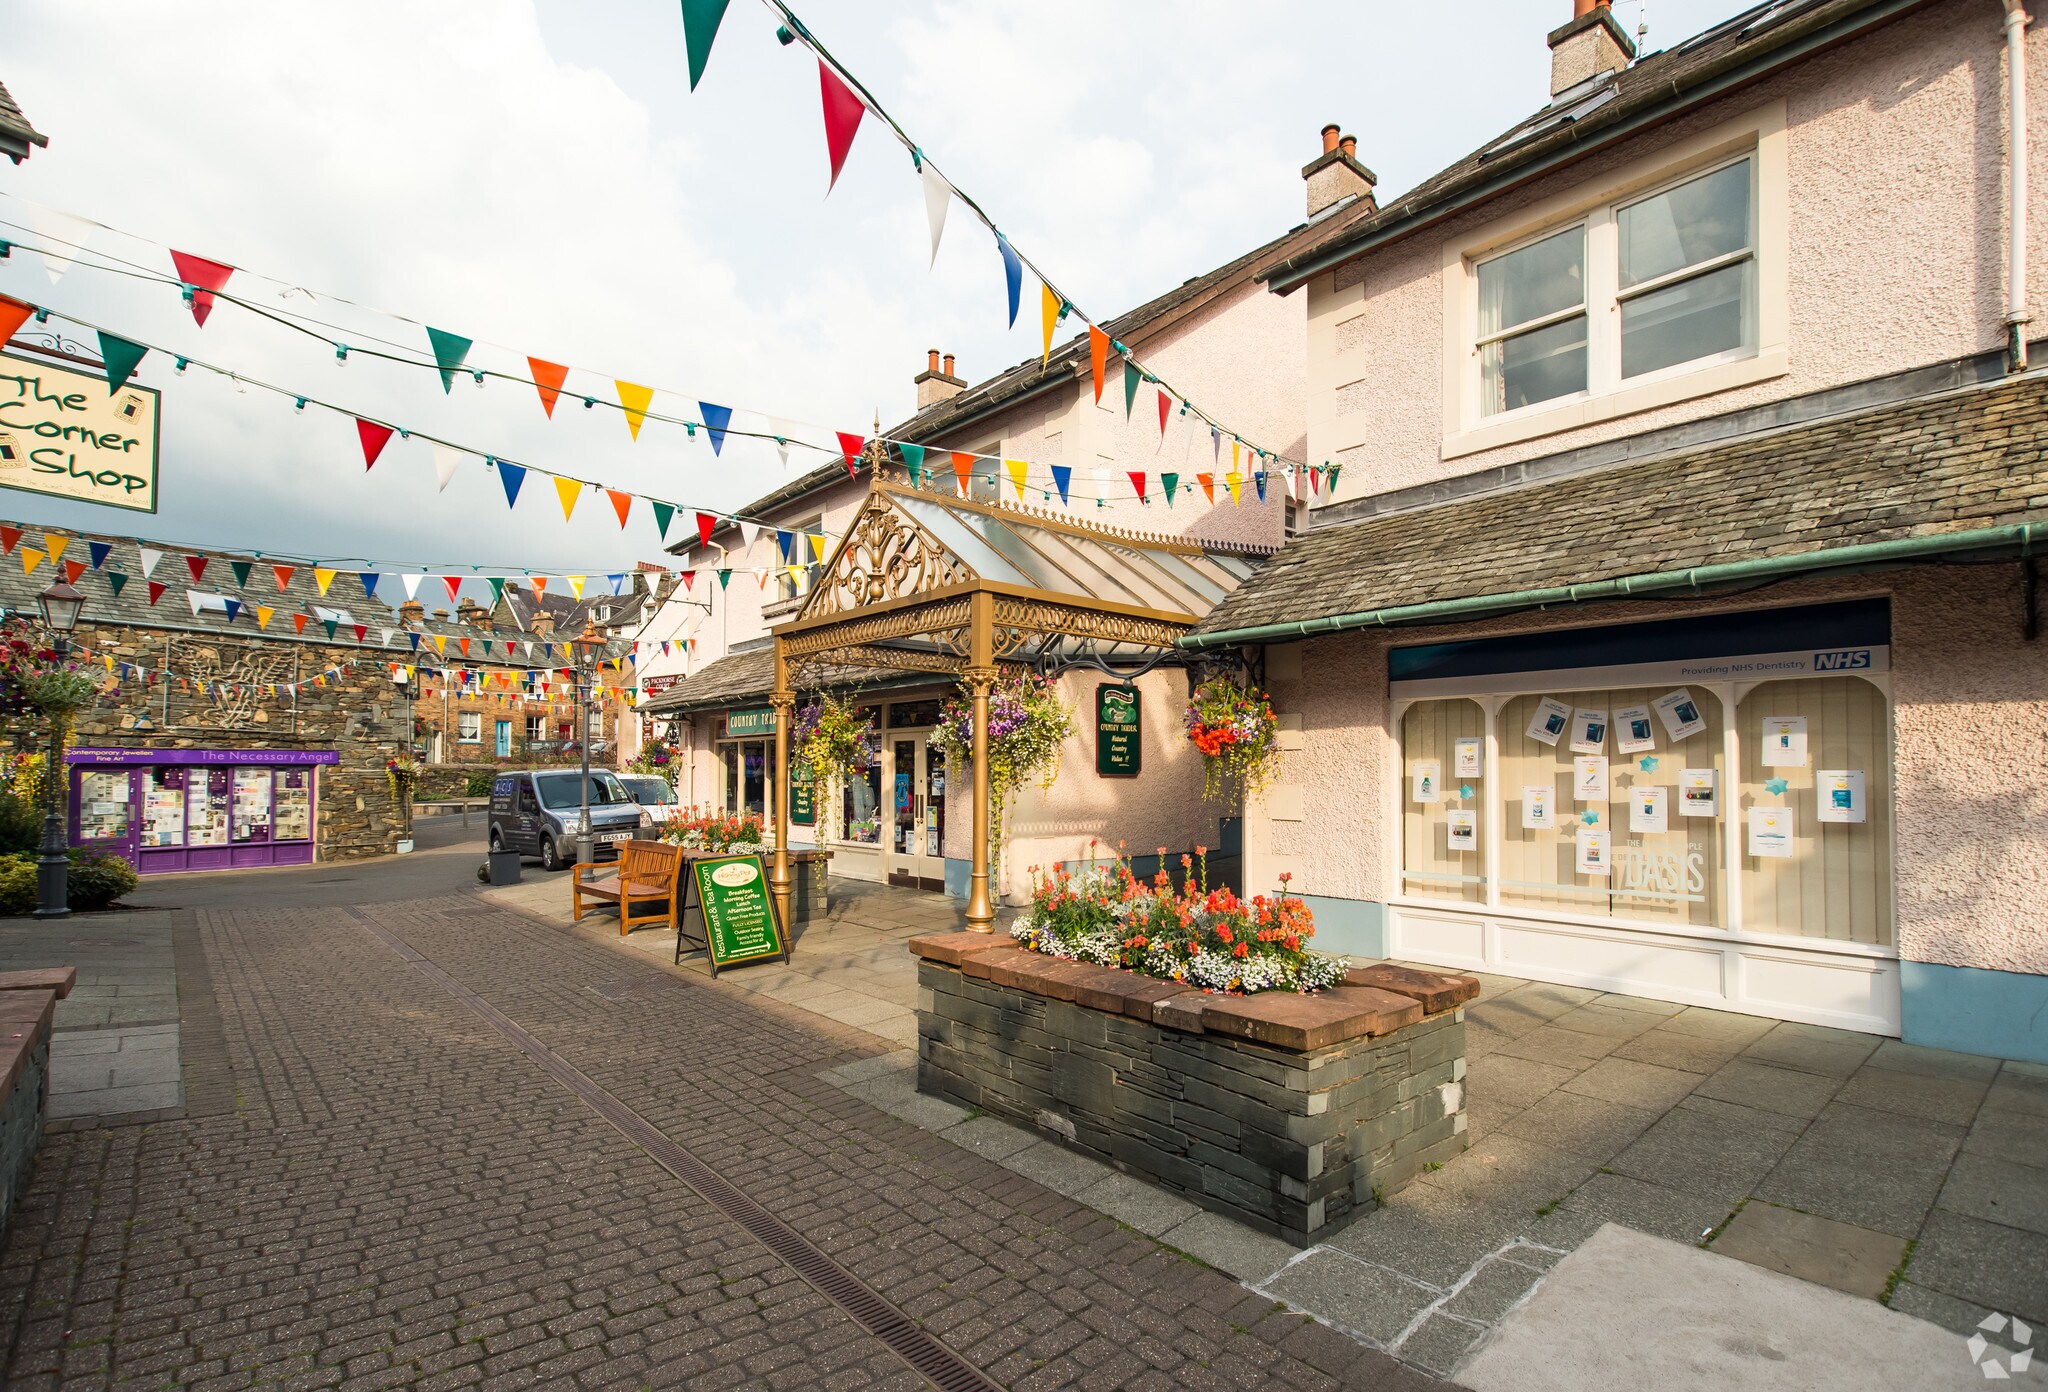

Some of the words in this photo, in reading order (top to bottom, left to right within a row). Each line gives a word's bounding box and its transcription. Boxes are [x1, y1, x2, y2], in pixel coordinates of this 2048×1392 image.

[0, 374, 88, 412] The
[0, 401, 141, 453] Corner
[29, 448, 148, 494] Shop
[1681, 665, 1728, 675] Providing
[1731, 662, 1754, 672] NHS
[1756, 660, 1806, 670] Dentistry
[1815, 651, 1869, 670] NHS
[730, 714, 758, 728] COUNTRY
[200, 751, 225, 760] The
[229, 751, 296, 762] Necessary
[299, 752, 333, 762] Angel
[701, 866, 712, 891] Room
[1625, 849, 1705, 893] OASIS
[706, 891, 716, 907] Tea
[711, 914, 726, 958] Restaurant
